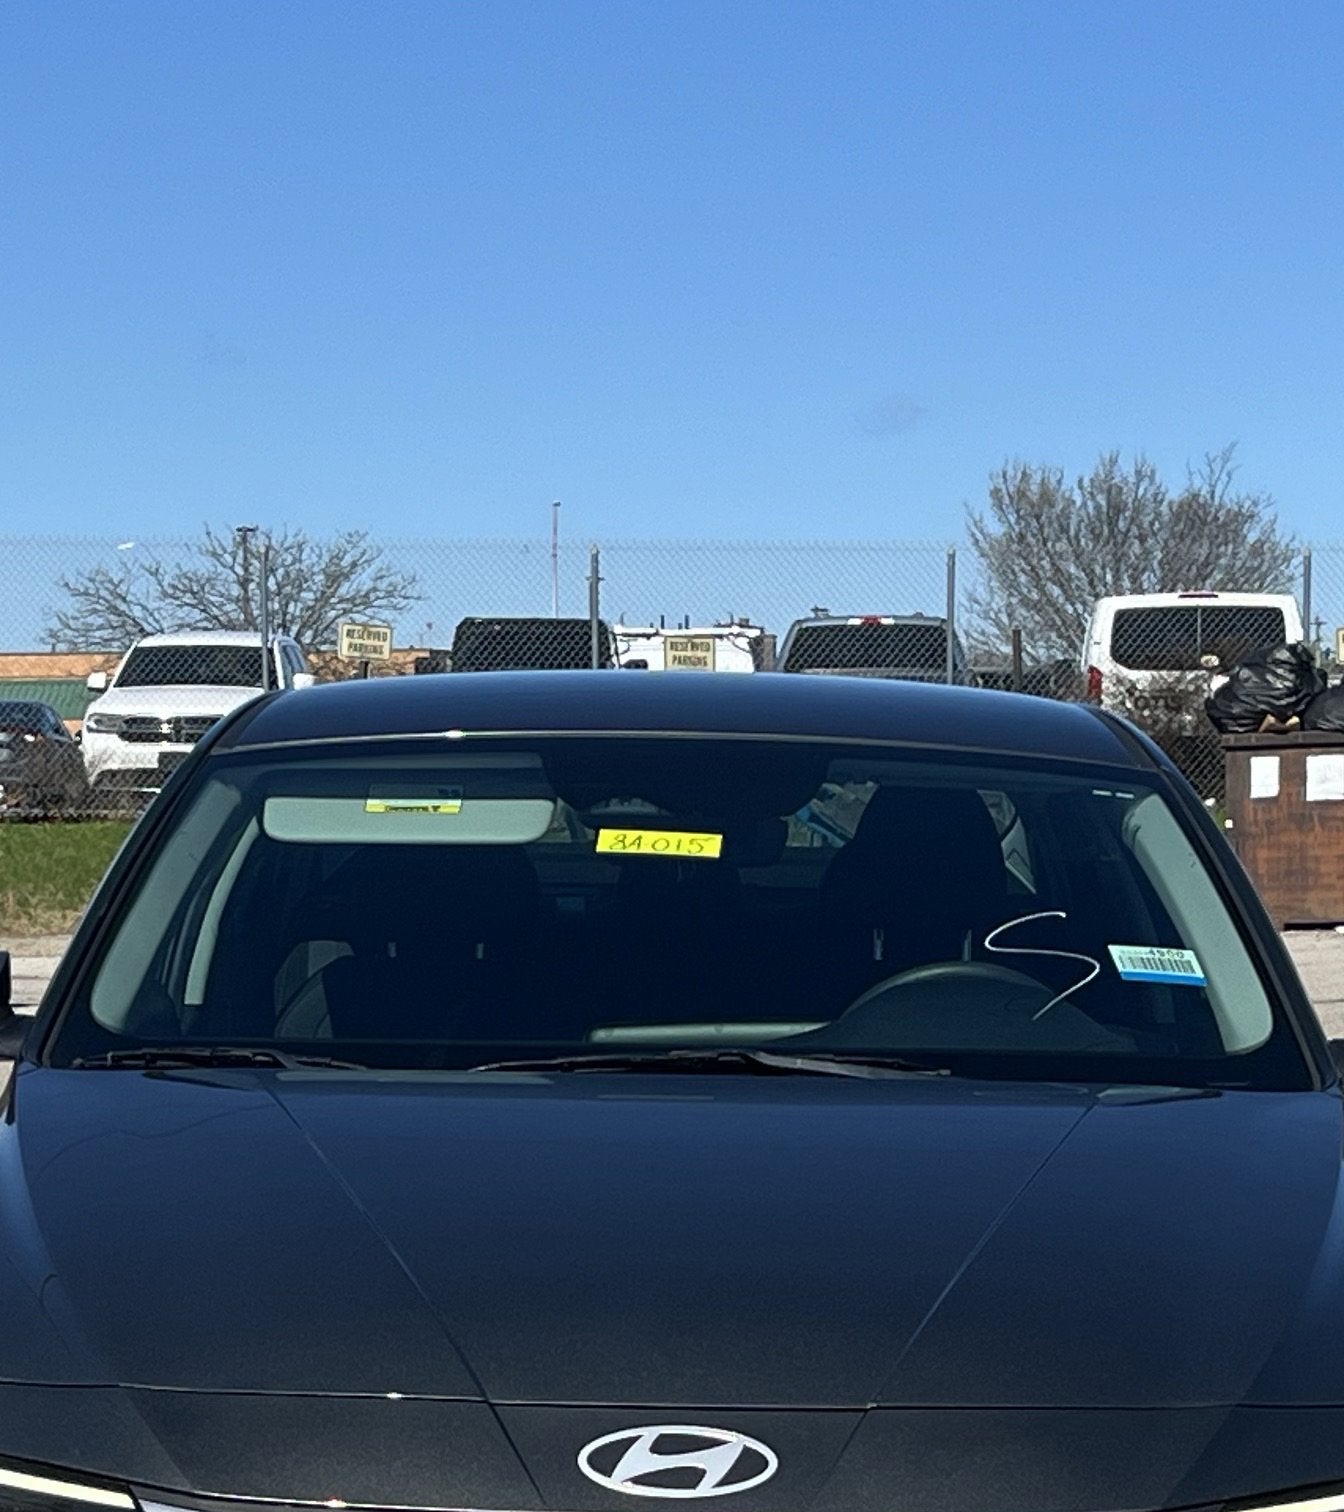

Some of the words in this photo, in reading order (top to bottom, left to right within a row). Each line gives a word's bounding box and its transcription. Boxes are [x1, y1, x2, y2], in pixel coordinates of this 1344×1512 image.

[346, 628, 388, 642] RESERVED
[669, 641, 711, 653] RESERVED
[672, 655, 708, 667] PARKING
